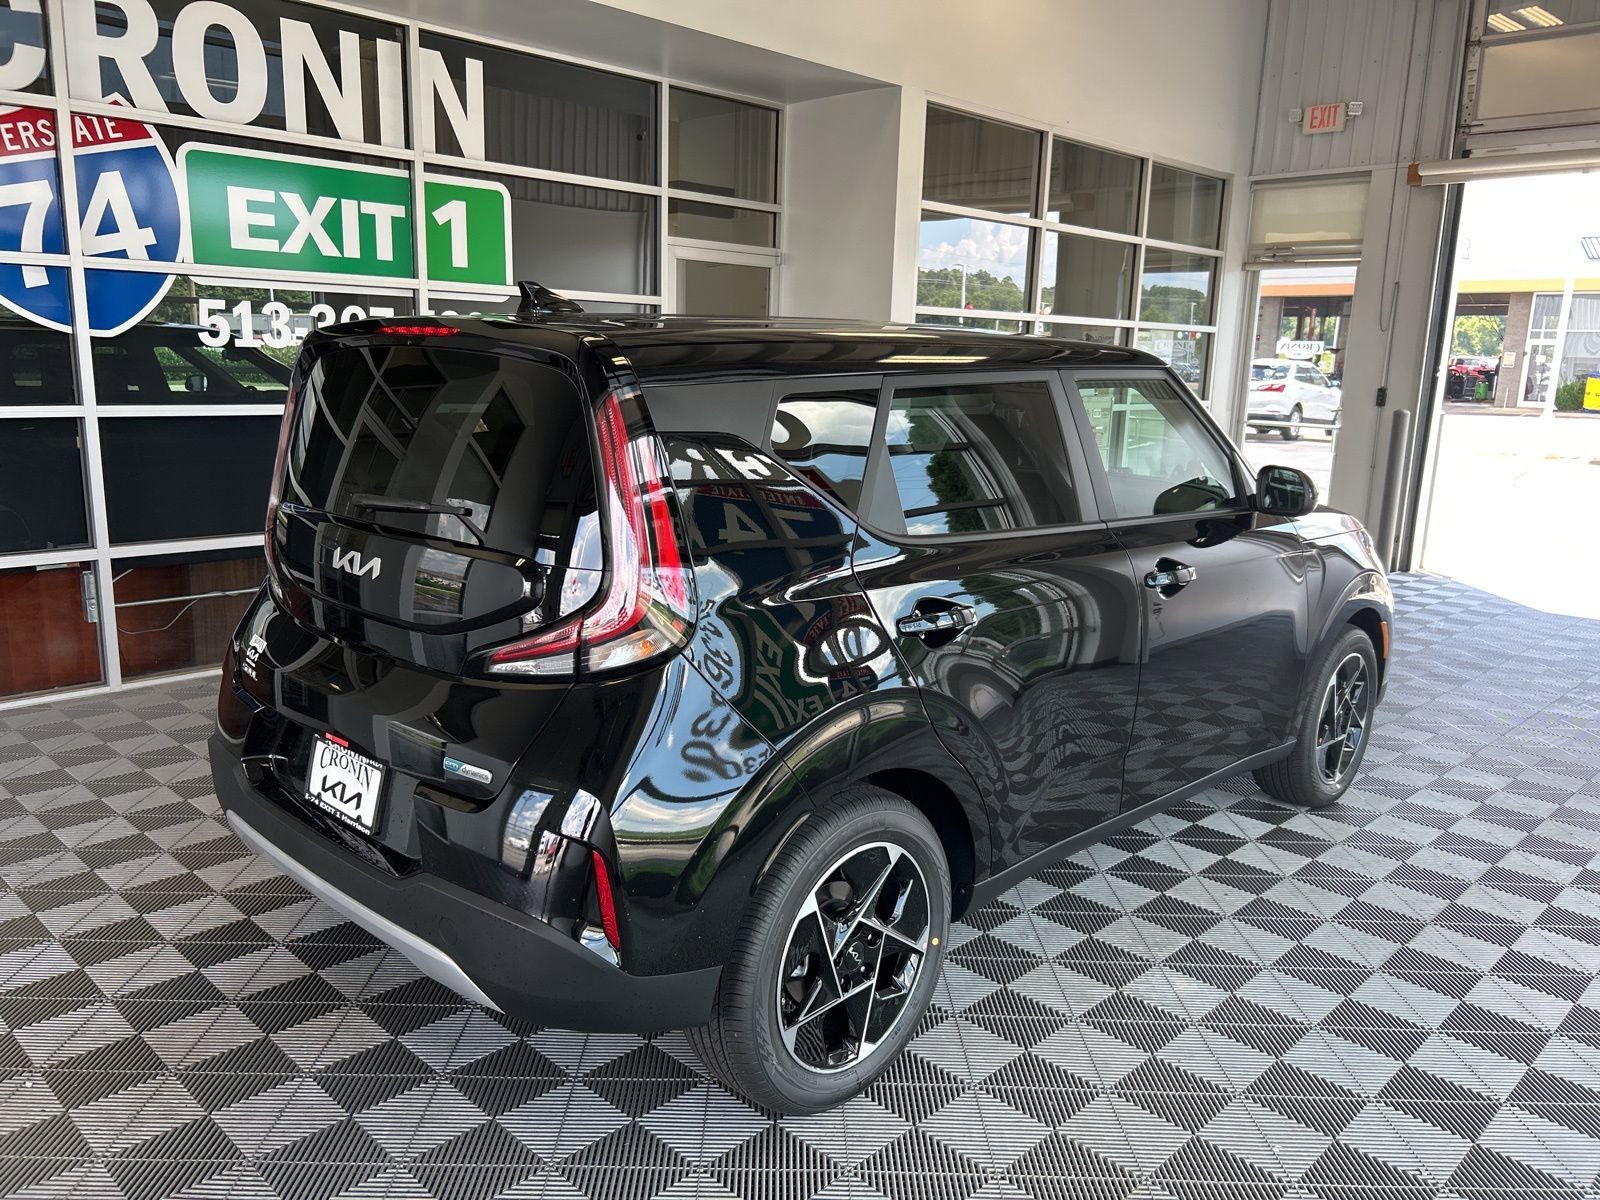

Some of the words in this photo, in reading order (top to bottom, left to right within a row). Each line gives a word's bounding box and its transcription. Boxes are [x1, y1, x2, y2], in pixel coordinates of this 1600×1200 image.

[1309, 105, 1341, 128] EXIT
[0, 170, 158, 289] 74
[226, 185, 406, 262] EXIT
[431, 199, 469, 269] 1
[332, 546, 381, 580] KIA
[320, 746, 375, 793] CRONIN
[321, 775, 363, 811] KIA
[320, 801, 335, 815] EXIT
[341, 814, 371, 836] Harrison
